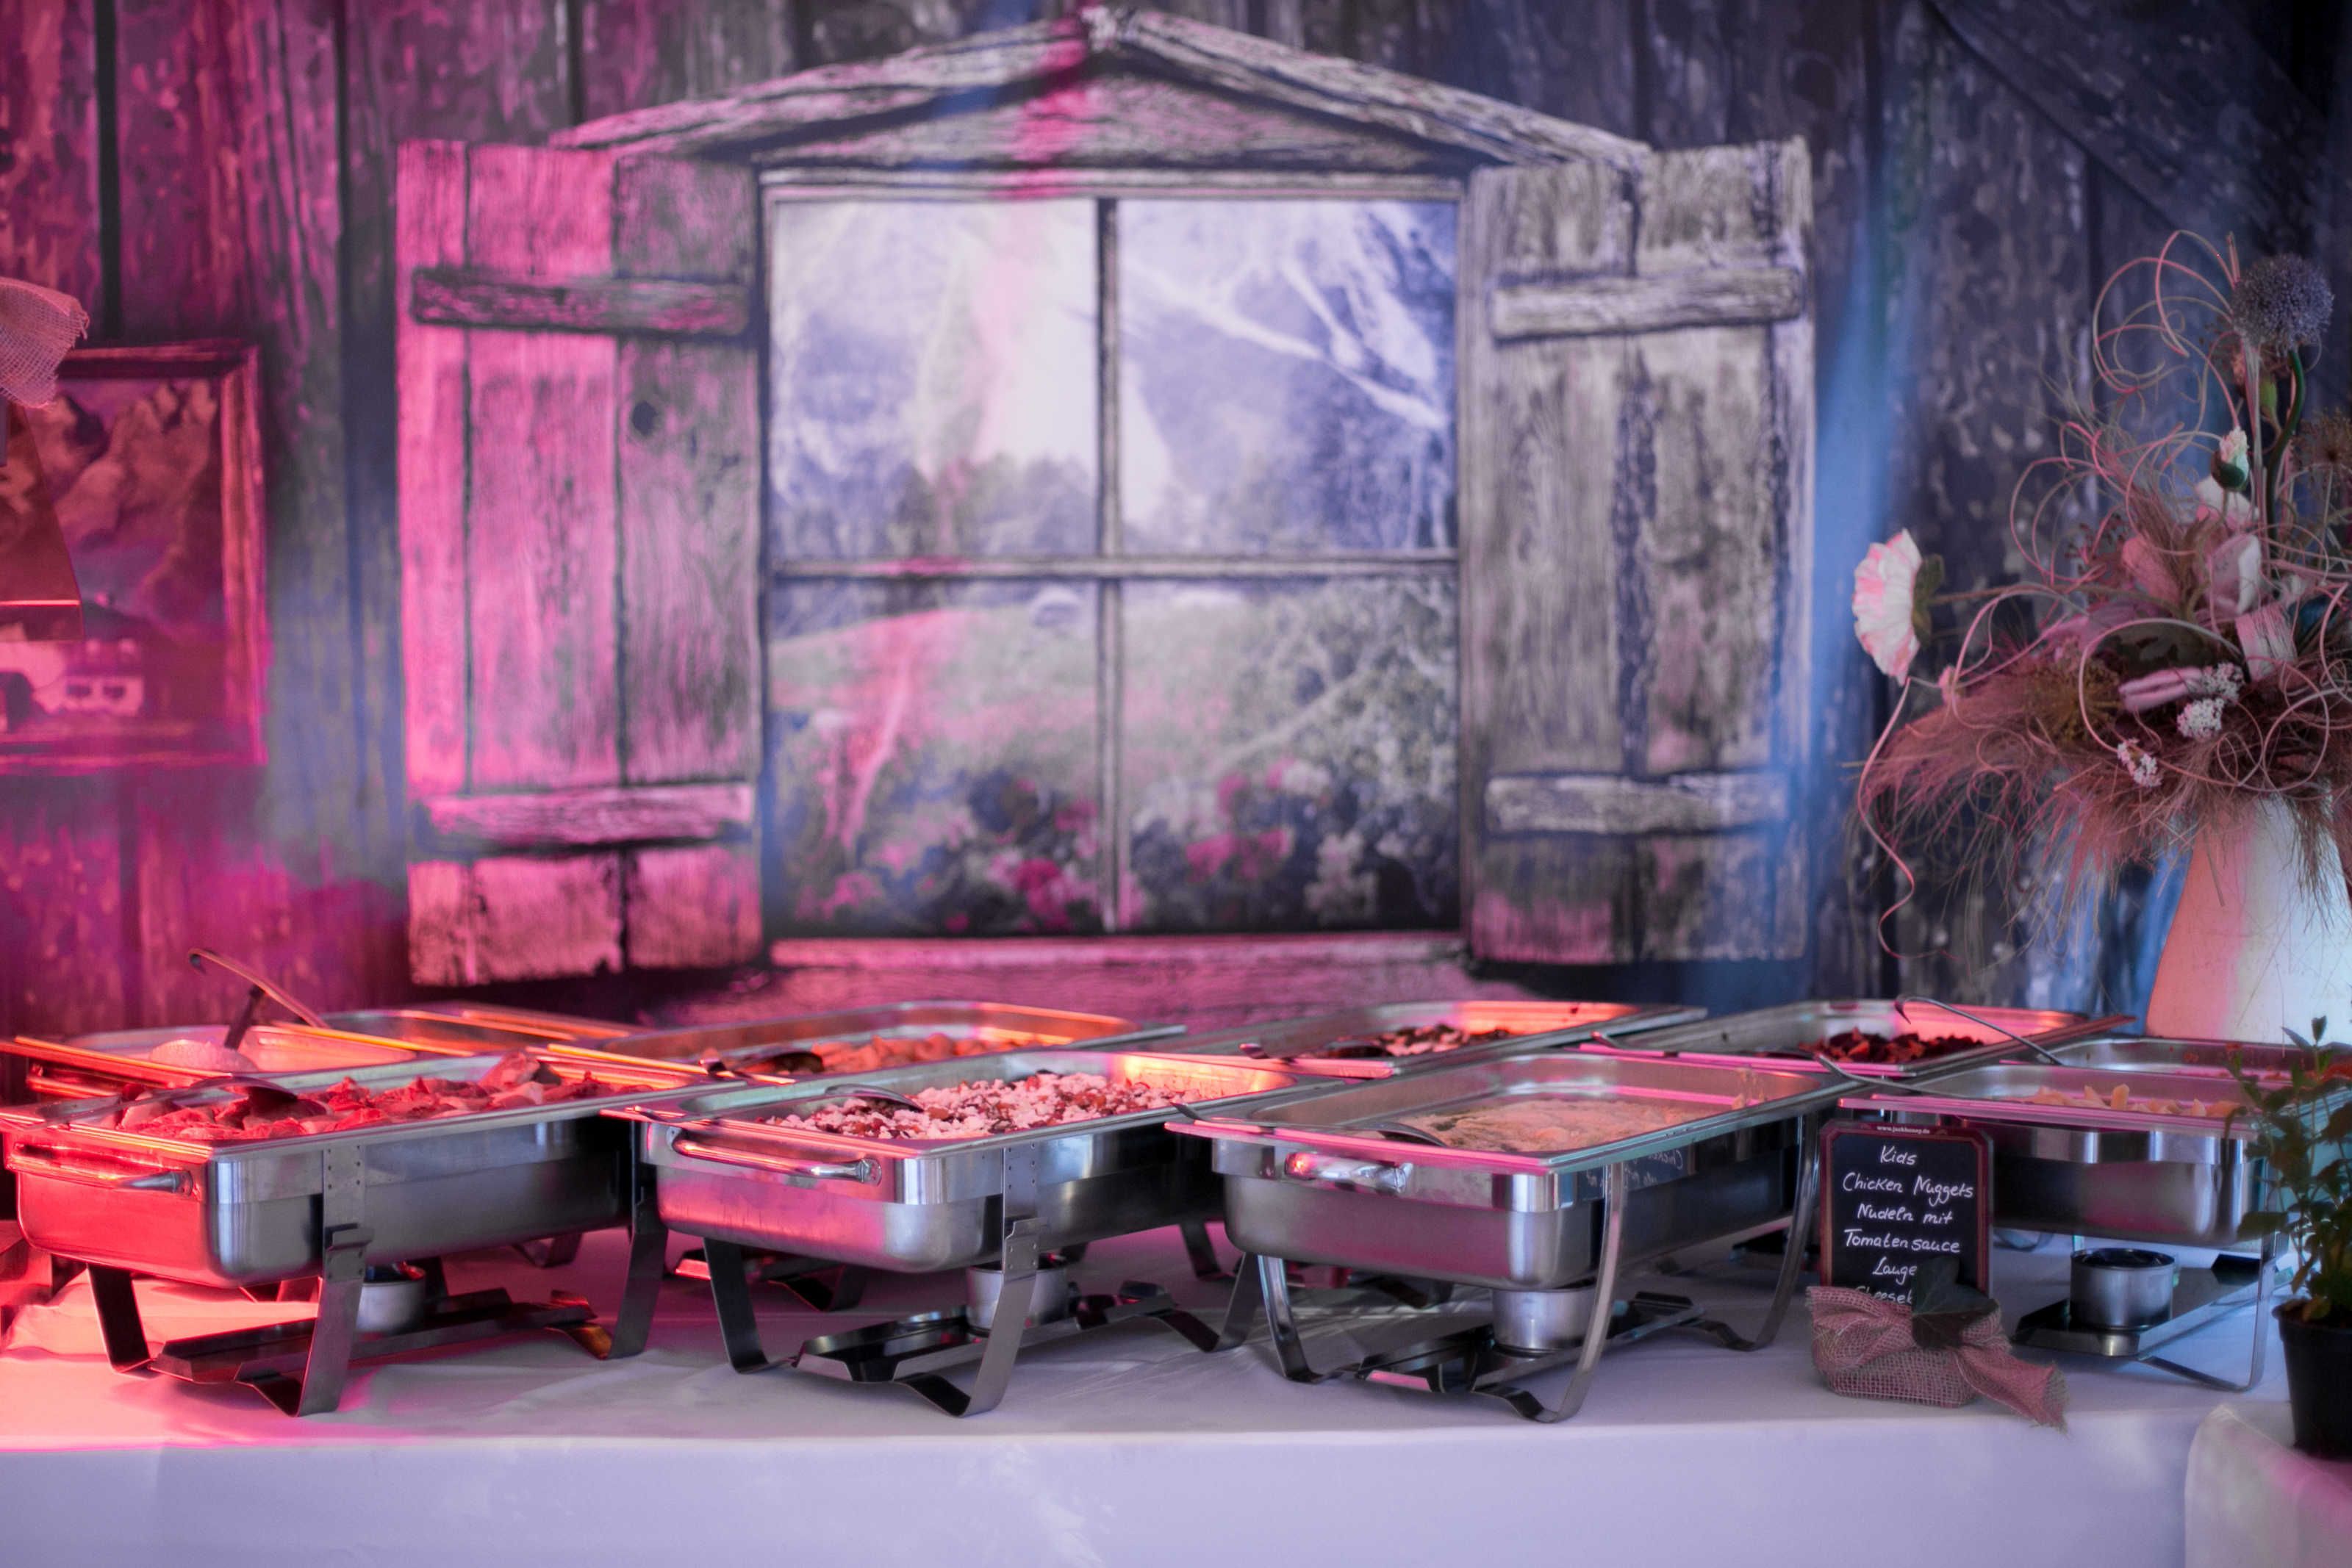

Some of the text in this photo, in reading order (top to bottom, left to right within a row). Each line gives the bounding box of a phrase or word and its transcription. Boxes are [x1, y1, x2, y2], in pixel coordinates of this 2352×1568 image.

[1880, 1146, 1918, 1165] Kids
[1843, 1172, 1974, 1207] Chicken Nuggets
[1857, 1204, 1953, 1224] Nudeln mit
